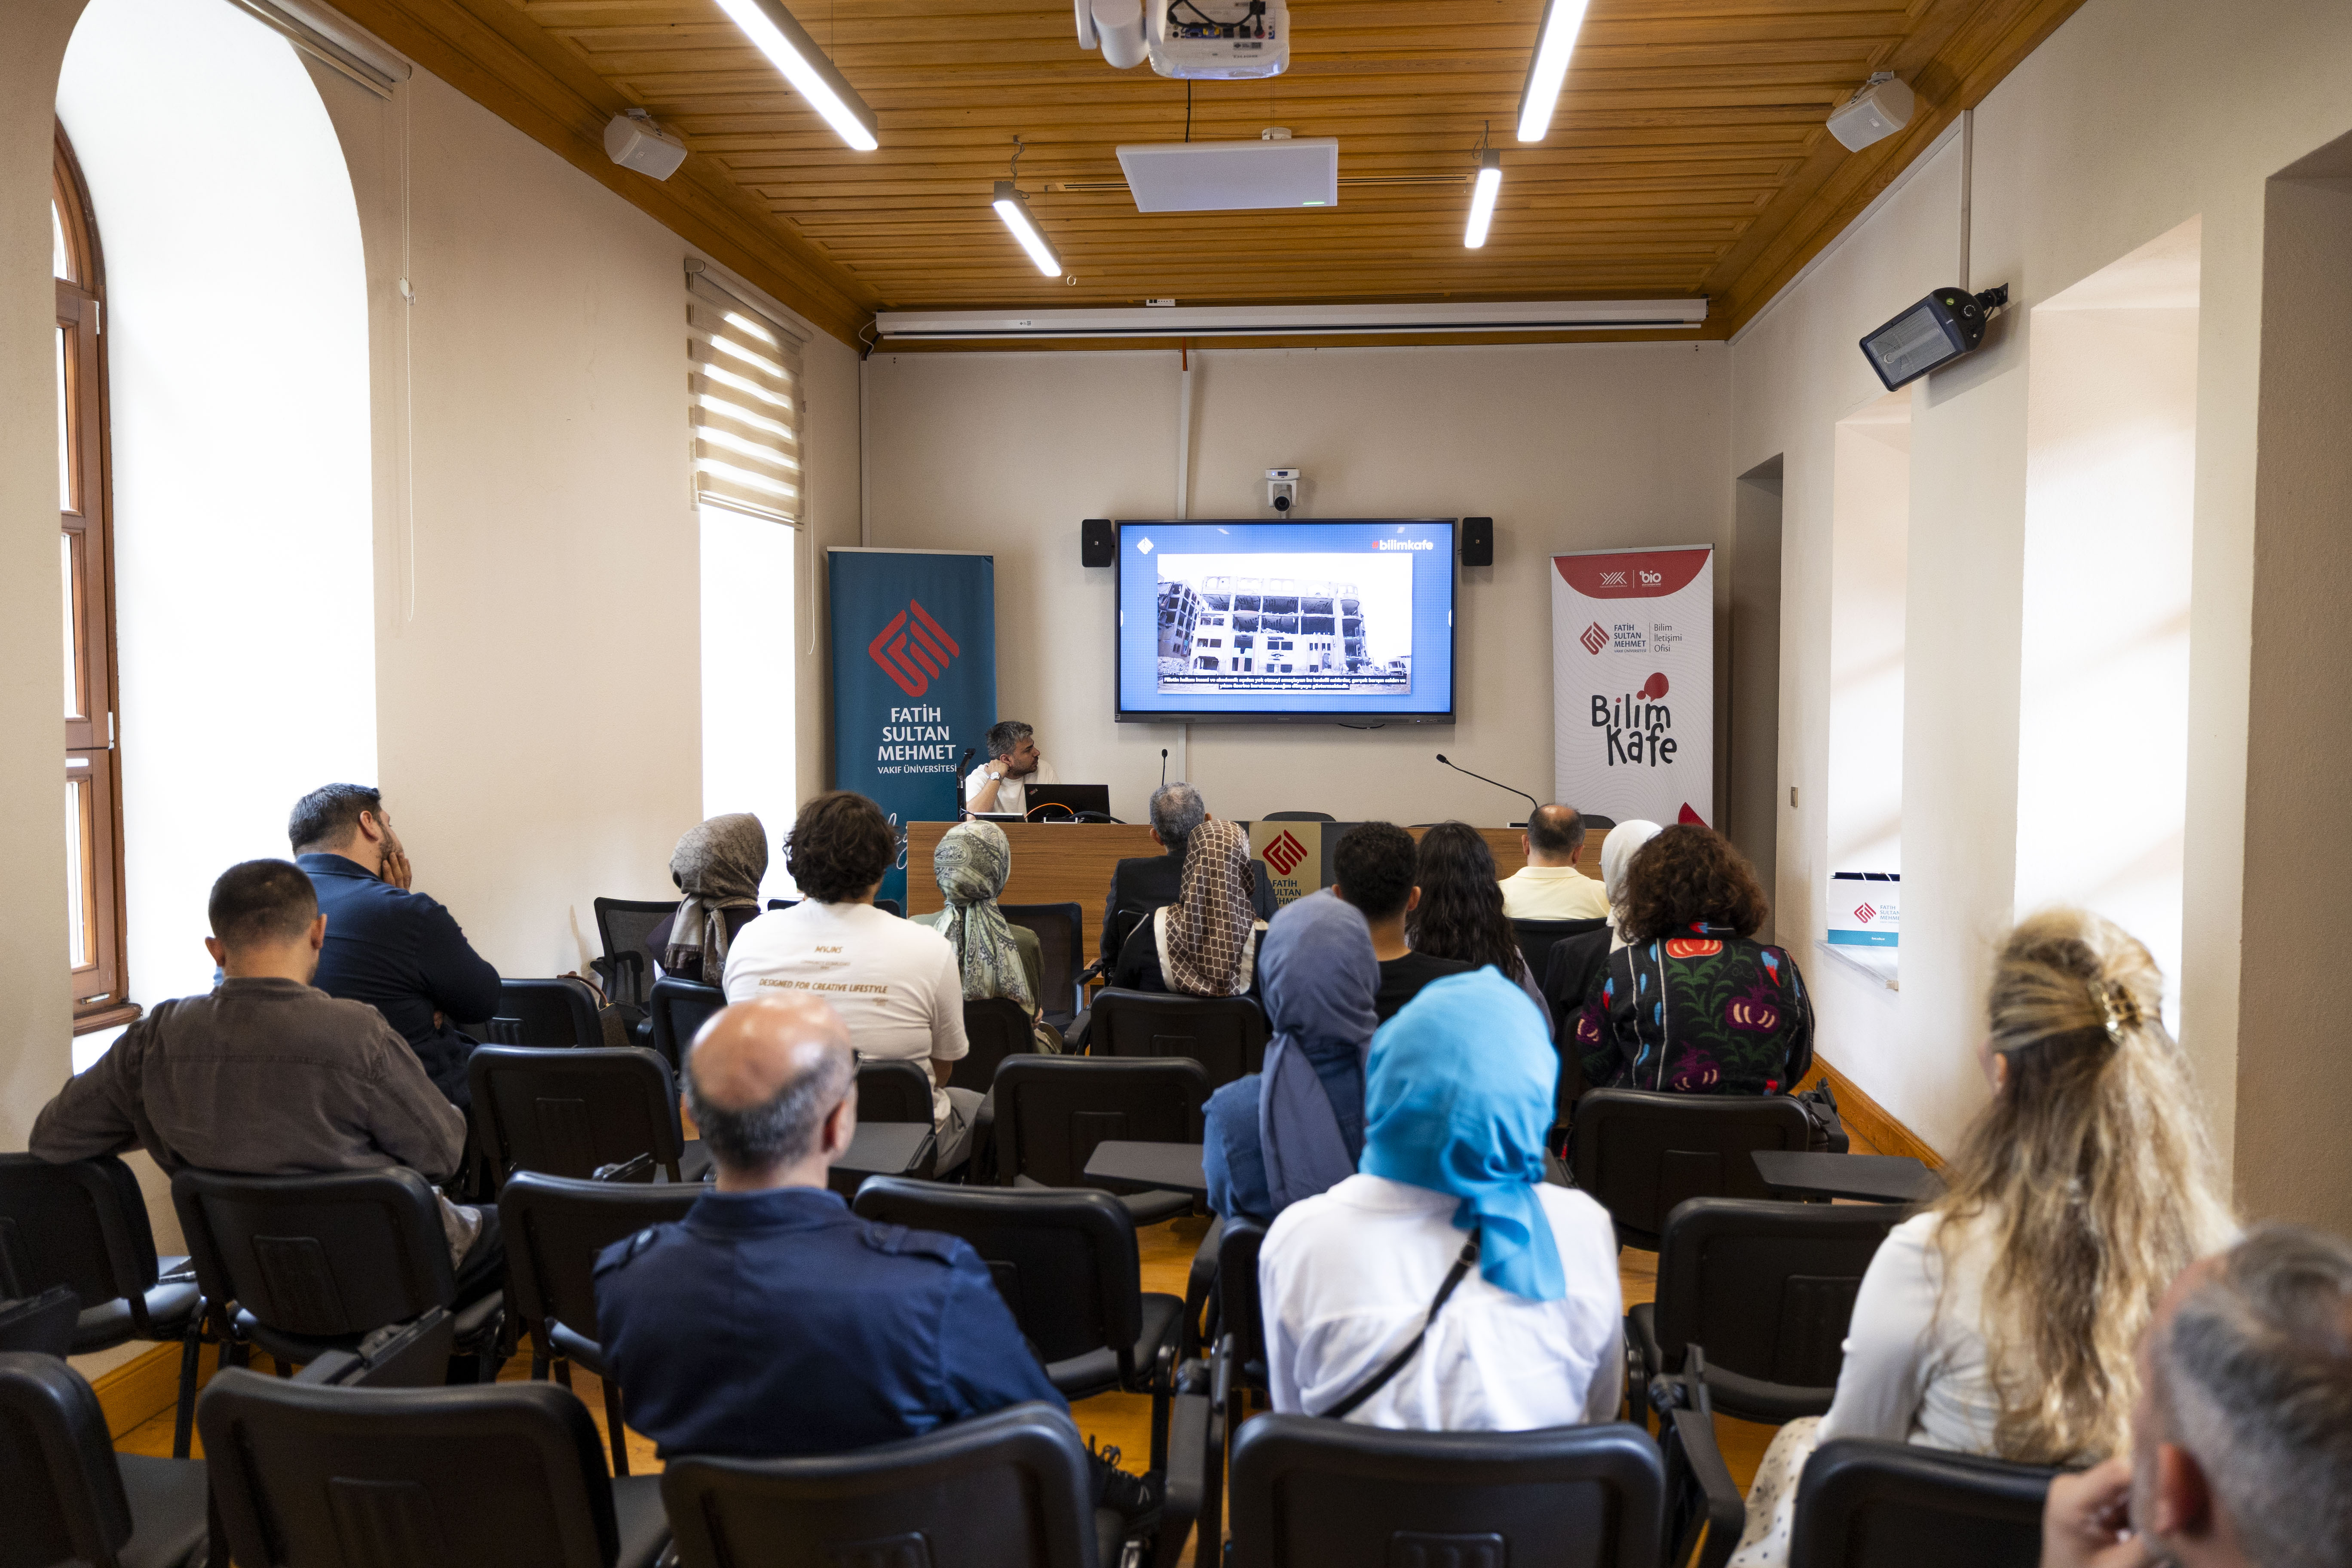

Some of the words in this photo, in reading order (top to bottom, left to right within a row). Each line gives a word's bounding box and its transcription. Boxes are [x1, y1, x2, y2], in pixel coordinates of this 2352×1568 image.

[1372, 539, 1433, 550] #bilimkafe
[1639, 570, 1661, 583] bio
[1614, 623, 1634, 631] FATİH
[1654, 633, 1682, 643] İletişimi
[891, 704, 940, 722] FATİH
[1592, 693, 1671, 730] Bilim
[883, 726, 949, 741] SULTAN
[1606, 723, 1677, 767] Kafe
[878, 745, 956, 760] MEHMET
[904, 763, 957, 773] ÜNİVERSİTESİ
[1273, 879, 1297, 887] FATİH
[759, 978, 793, 988] DESIGNED
[812, 983, 847, 992] CREATIVE
[849, 984, 888, 994] LIFESTYLE
